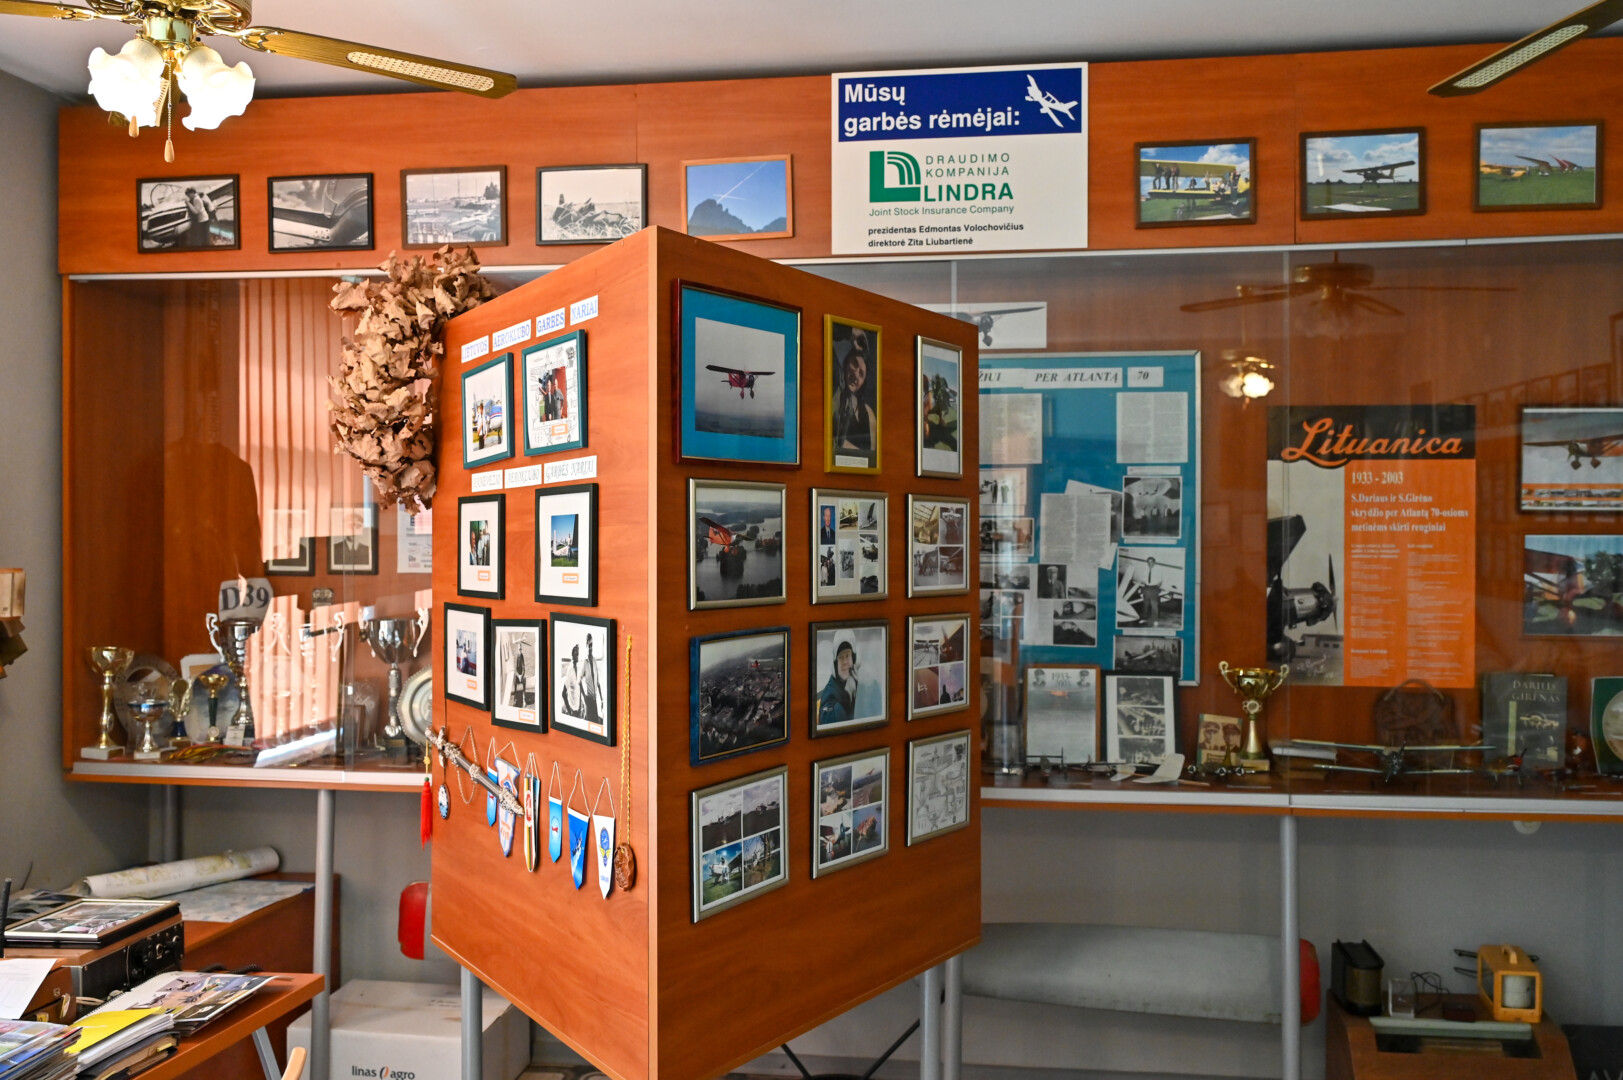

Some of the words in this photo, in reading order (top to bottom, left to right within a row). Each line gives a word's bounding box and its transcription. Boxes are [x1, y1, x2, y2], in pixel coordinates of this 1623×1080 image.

[844, 84, 906, 106] Mūsų
[844, 111, 922, 137] garbės
[928, 106, 1021, 132] rėmėjai:
[925, 152, 1010, 165] DRAUDIMO
[925, 166, 1010, 178] KOMPANIJA
[924, 182, 1014, 202] LINDRA
[868, 207, 892, 217] Joint
[893, 206, 919, 216] Stock
[922, 206, 967, 215] Insurance
[969, 204, 1015, 215] Company
[868, 226, 917, 236] prezidentas
[919, 225, 962, 233] Edmontas
[963, 222, 1024, 232] Volochovičius
[868, 239, 906, 247] direktorė
[907, 238, 924, 246] Zita
[925, 236, 974, 246] Liubartienė
[462, 340, 488, 361] LIETUVOS
[493, 323, 530, 348] AEROKLUBO
[571, 299, 598, 322] NARIAI
[1034, 372, 1058, 383] PER
[1063, 371, 1120, 384] ATLANTĄ
[1137, 370, 1150, 380] 70
[1280, 416, 1464, 468] Lituanica
[1351, 471, 1373, 485] 1933
[1381, 471, 1404, 485] 2003
[221, 584, 270, 612] D39
[351, 1065, 377, 1077] linas
[389, 1070, 416, 1080] agro
